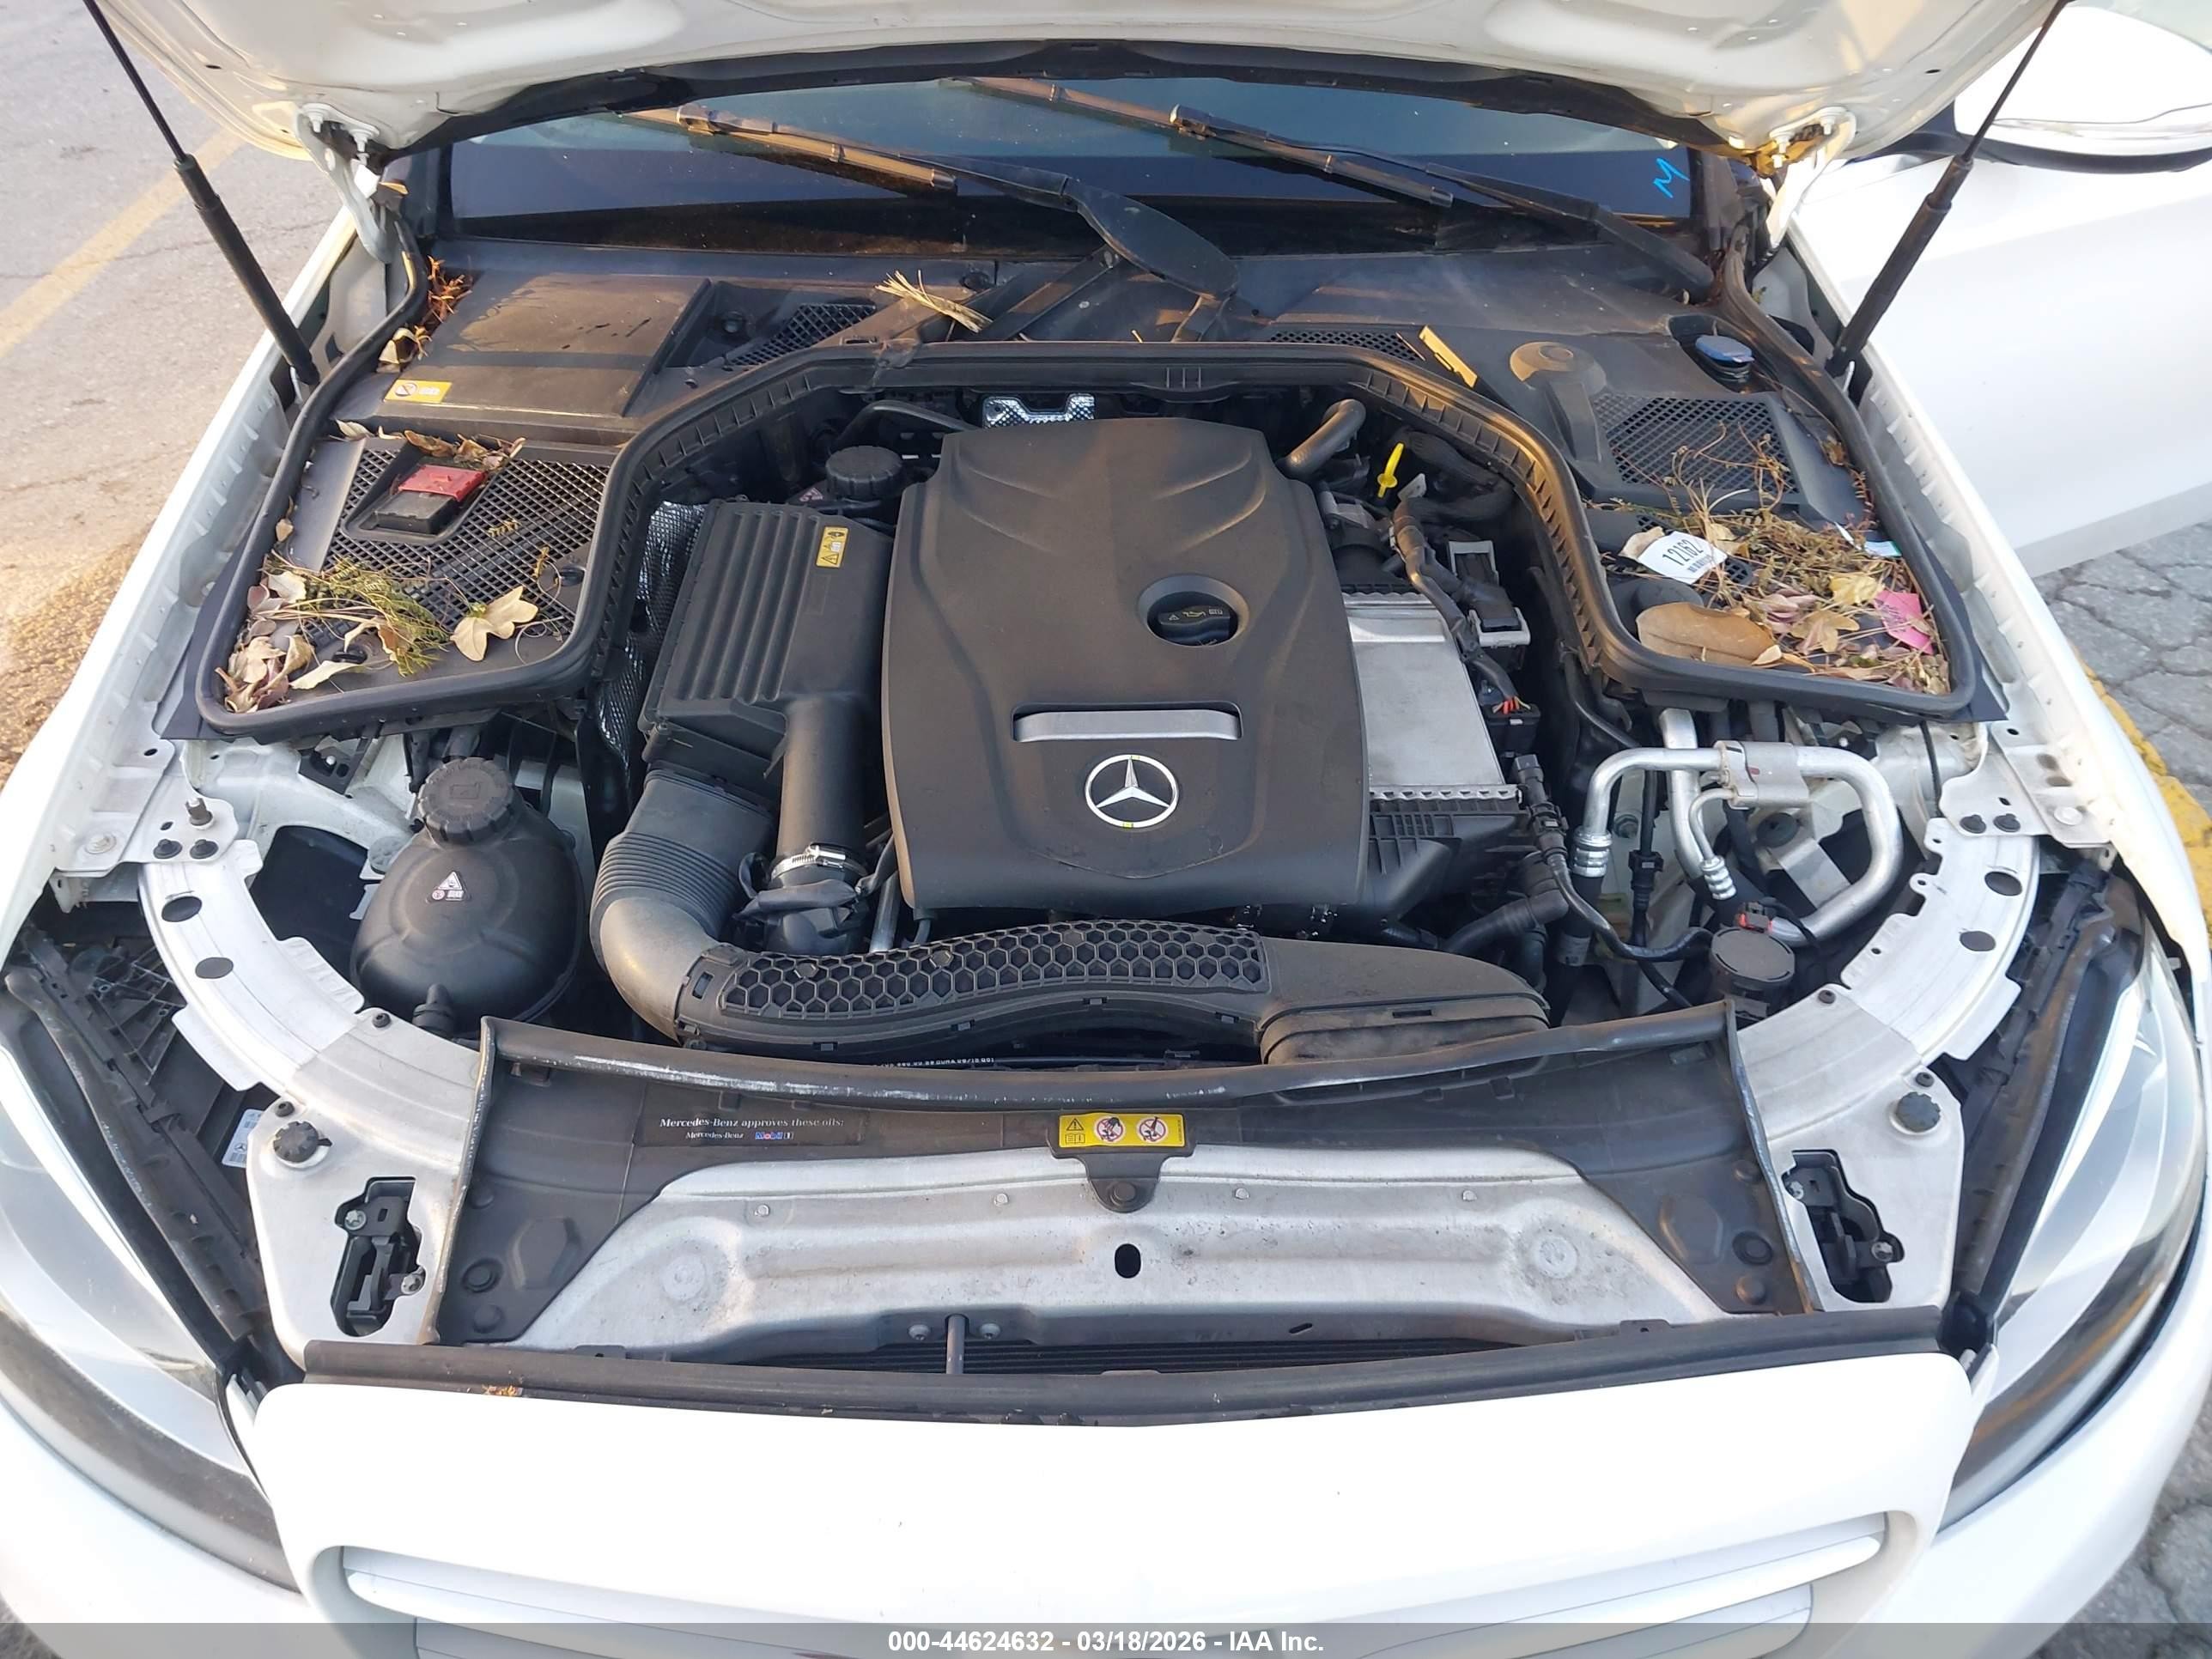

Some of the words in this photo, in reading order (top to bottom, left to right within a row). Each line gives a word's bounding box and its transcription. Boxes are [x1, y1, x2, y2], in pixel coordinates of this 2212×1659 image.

[1662, 539, 1704, 566] 12162
[659, 1117, 738, 1127] Mercedes-Benz
[741, 1118, 788, 1129] approves
[791, 1117, 820, 1127] these
[685, 1131, 744, 1139] Mercedes-Benz
[755, 1131, 783, 1140] Mobil
